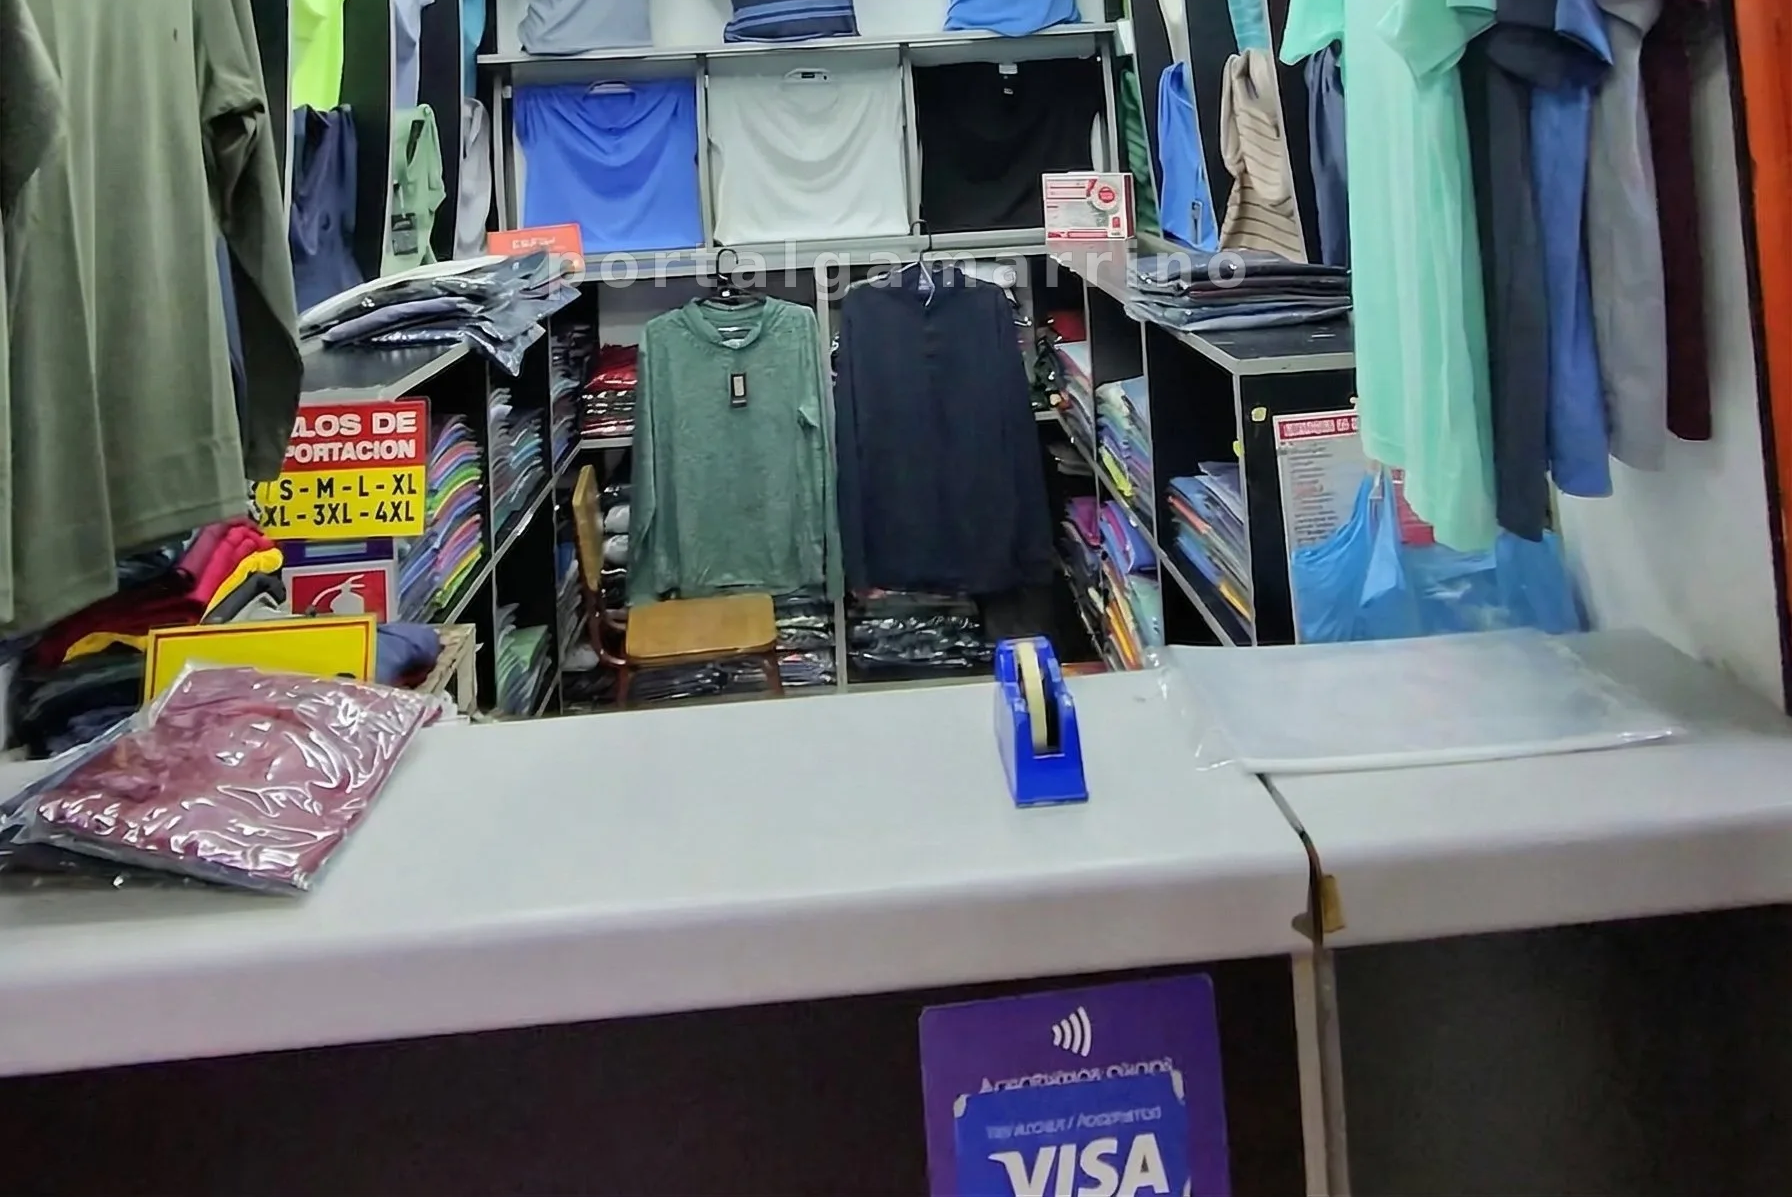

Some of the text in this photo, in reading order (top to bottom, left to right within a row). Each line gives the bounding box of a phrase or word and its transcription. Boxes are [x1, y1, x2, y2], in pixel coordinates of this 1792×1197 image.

[291, 410, 418, 438] LOS DE
[283, 438, 416, 464] PORTACION
[279, 479, 294, 501] S
[316, 476, 335, 499] M
[358, 475, 370, 497] L
[391, 473, 418, 496] XL
[262, 505, 291, 528] XL
[312, 502, 353, 526] 3XL
[374, 500, 415, 524] 4XL
[987, 1132, 1170, 1197] VISA
